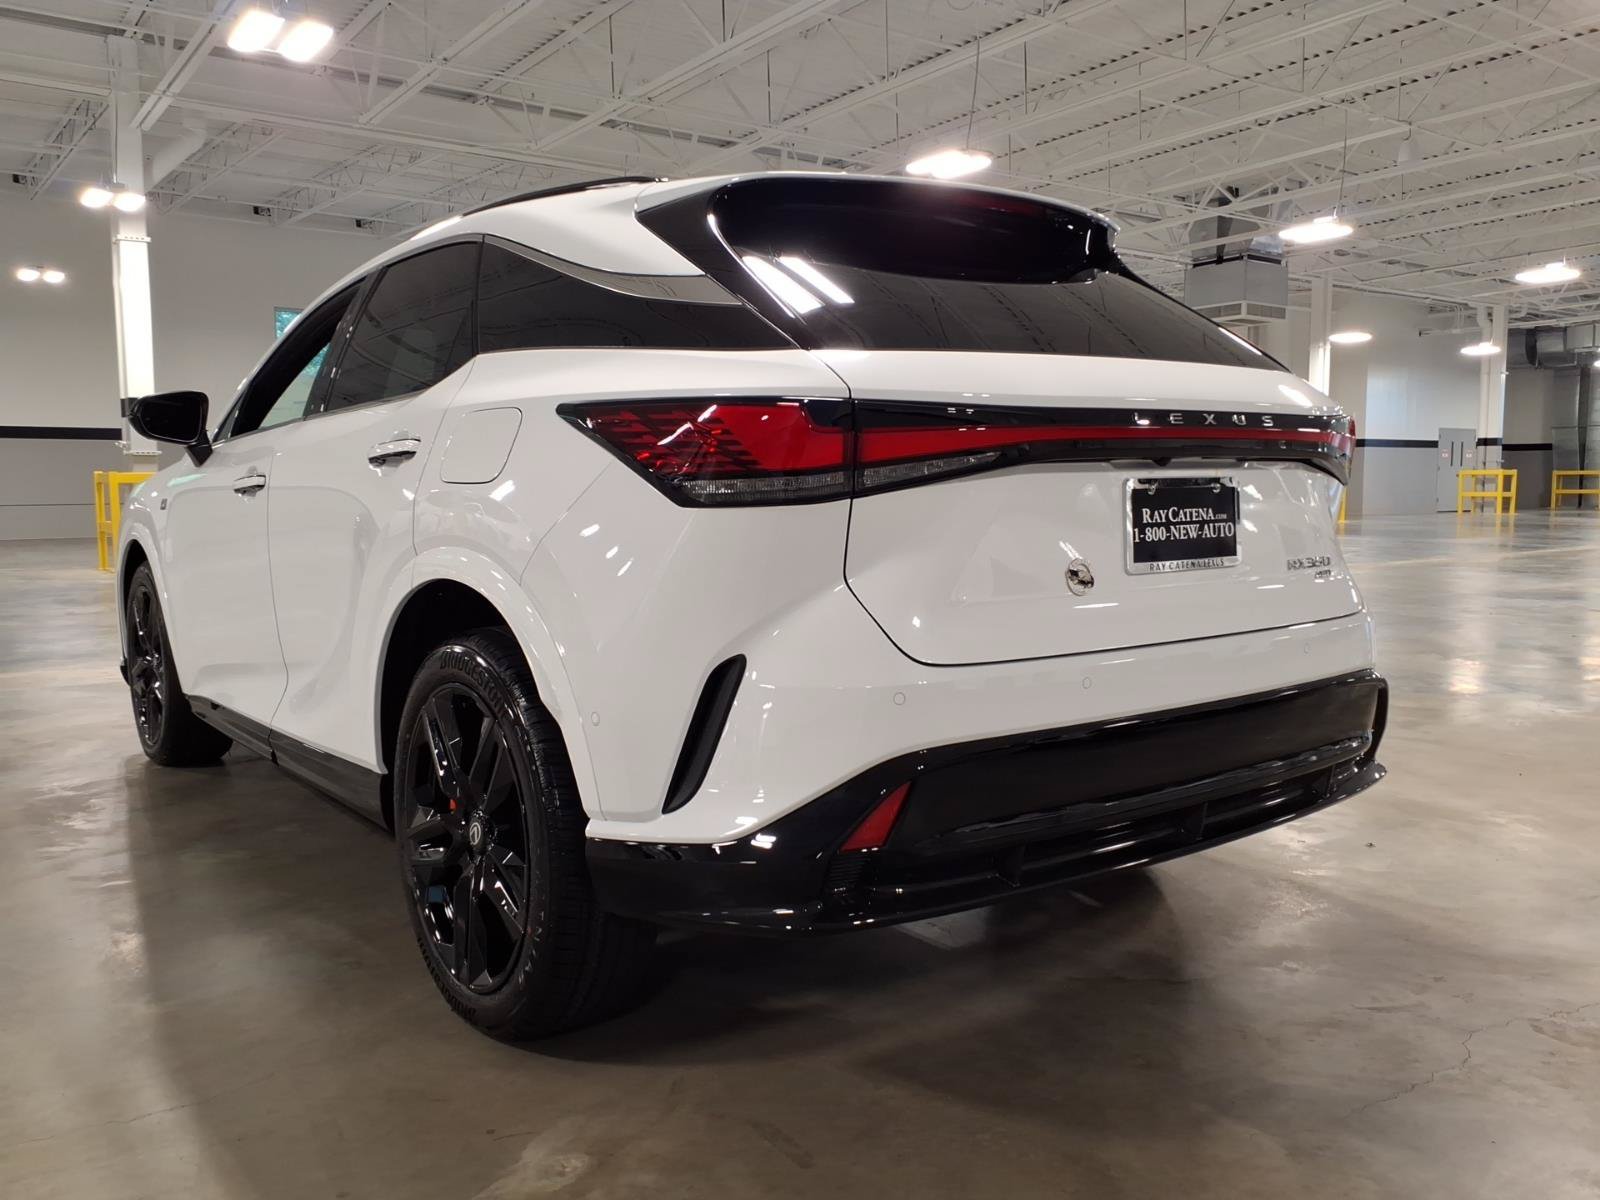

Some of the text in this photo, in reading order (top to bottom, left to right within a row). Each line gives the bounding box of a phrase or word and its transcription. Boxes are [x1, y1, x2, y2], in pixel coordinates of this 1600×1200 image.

[1134, 412, 1274, 427] LEXUS
[1134, 522, 1234, 543] 1-800-NEW-AUTO
[1149, 562, 1166, 572] RAY
[1168, 560, 1201, 570] CATENA
